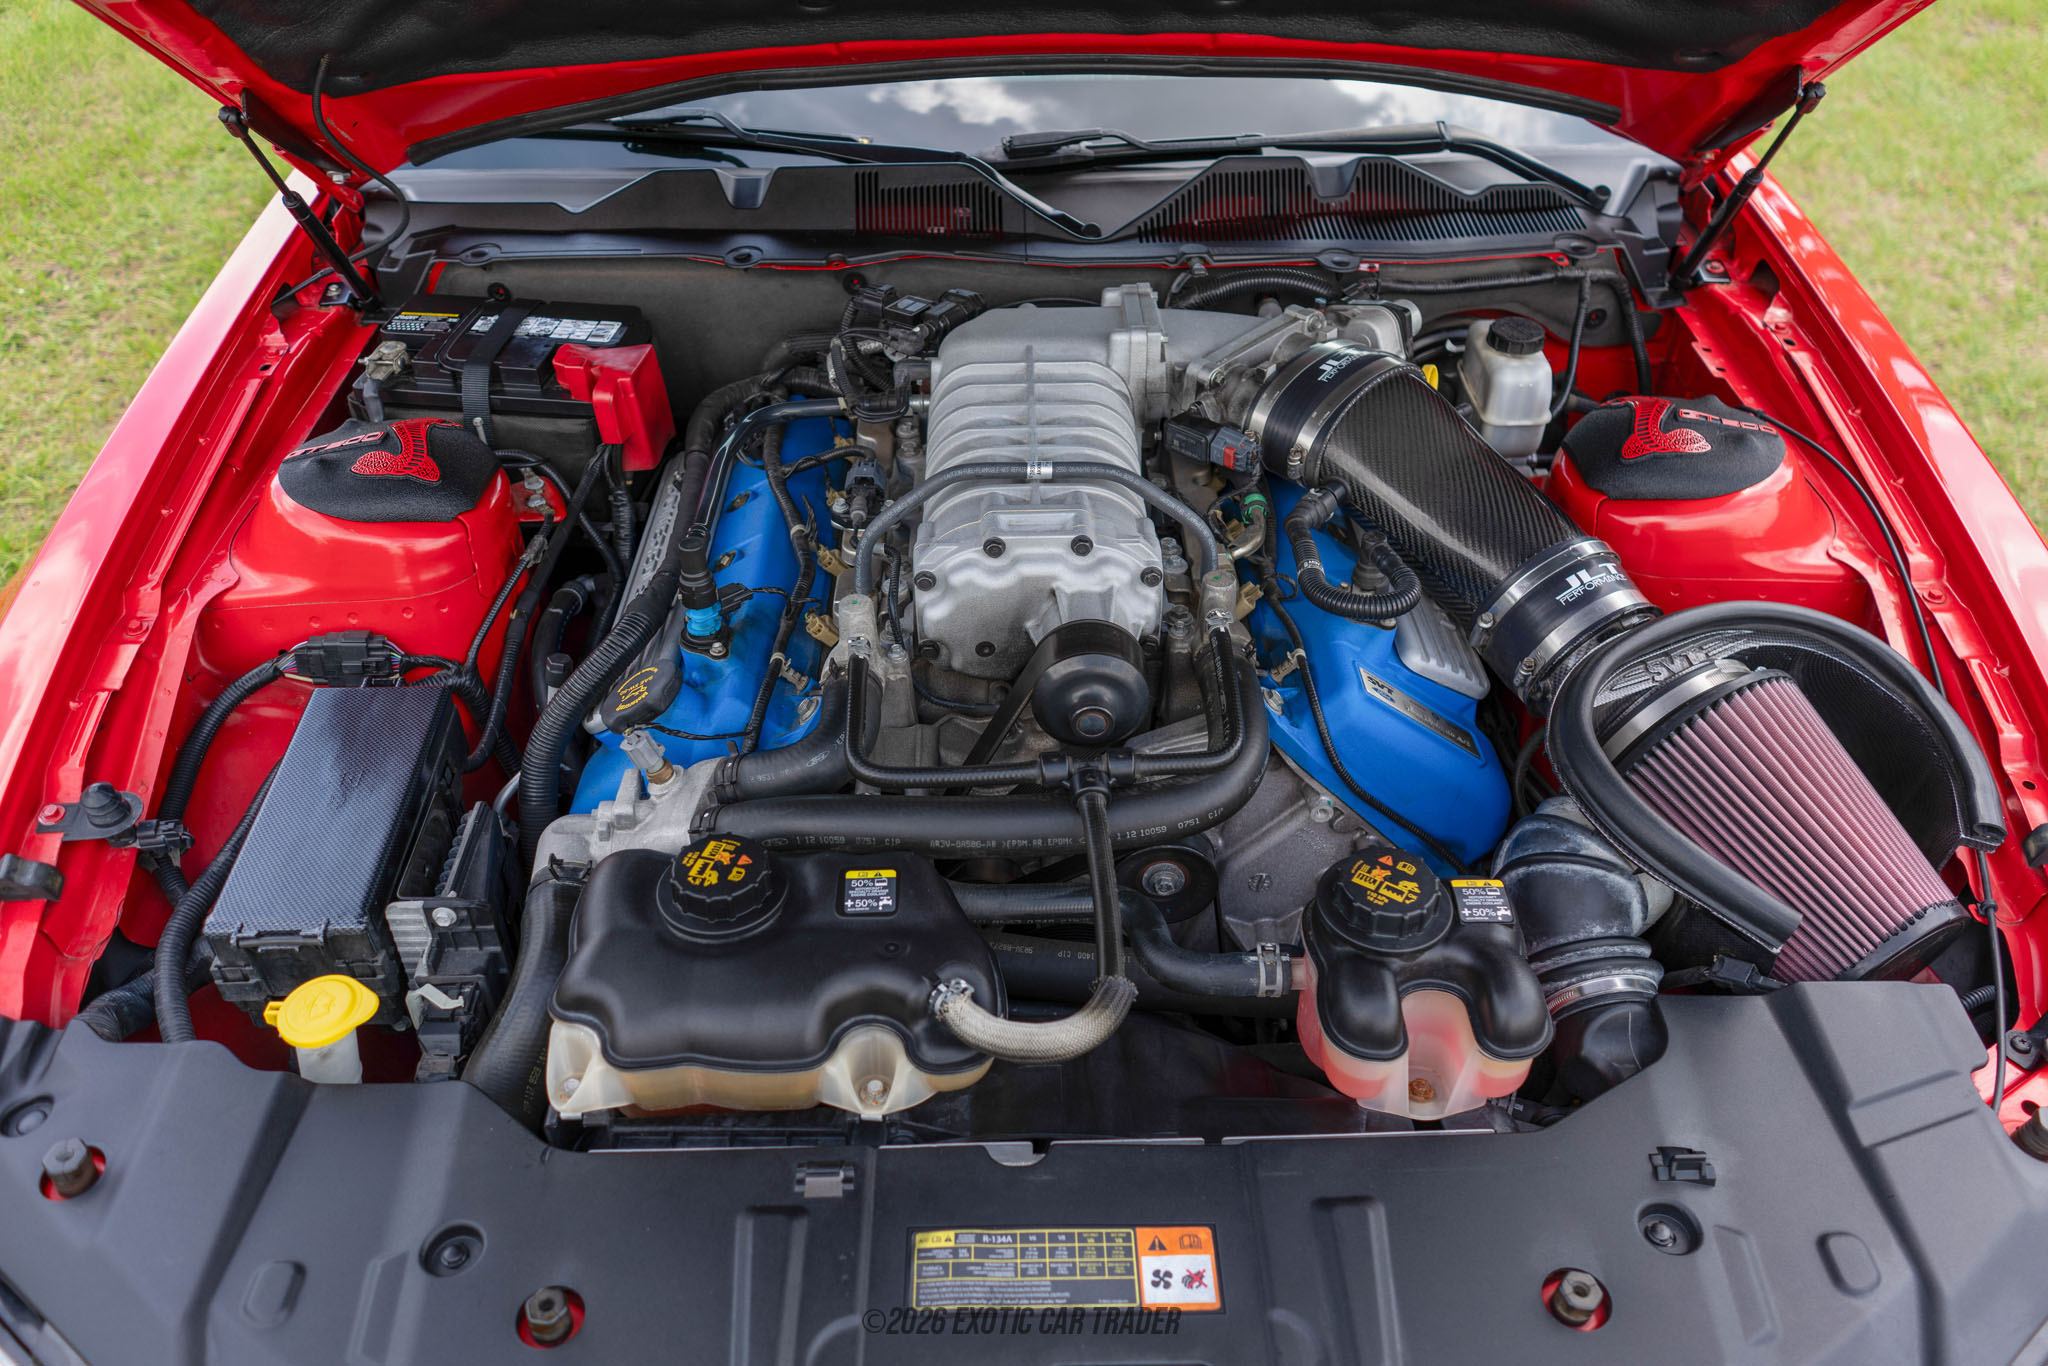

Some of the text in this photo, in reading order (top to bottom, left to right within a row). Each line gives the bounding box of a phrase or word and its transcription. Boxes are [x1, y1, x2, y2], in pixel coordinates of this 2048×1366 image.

[1556, 562, 1619, 600] JLT
[1559, 573, 1628, 606] PERFORMANCE
[1646, 648, 1707, 683] SVT
[1126, 830, 1137, 839] 12
[1140, 825, 1168, 837] 10059
[1177, 817, 1200, 830] 0751
[850, 879, 874, 887] 50%
[982, 1234, 1013, 1244] R-134A
